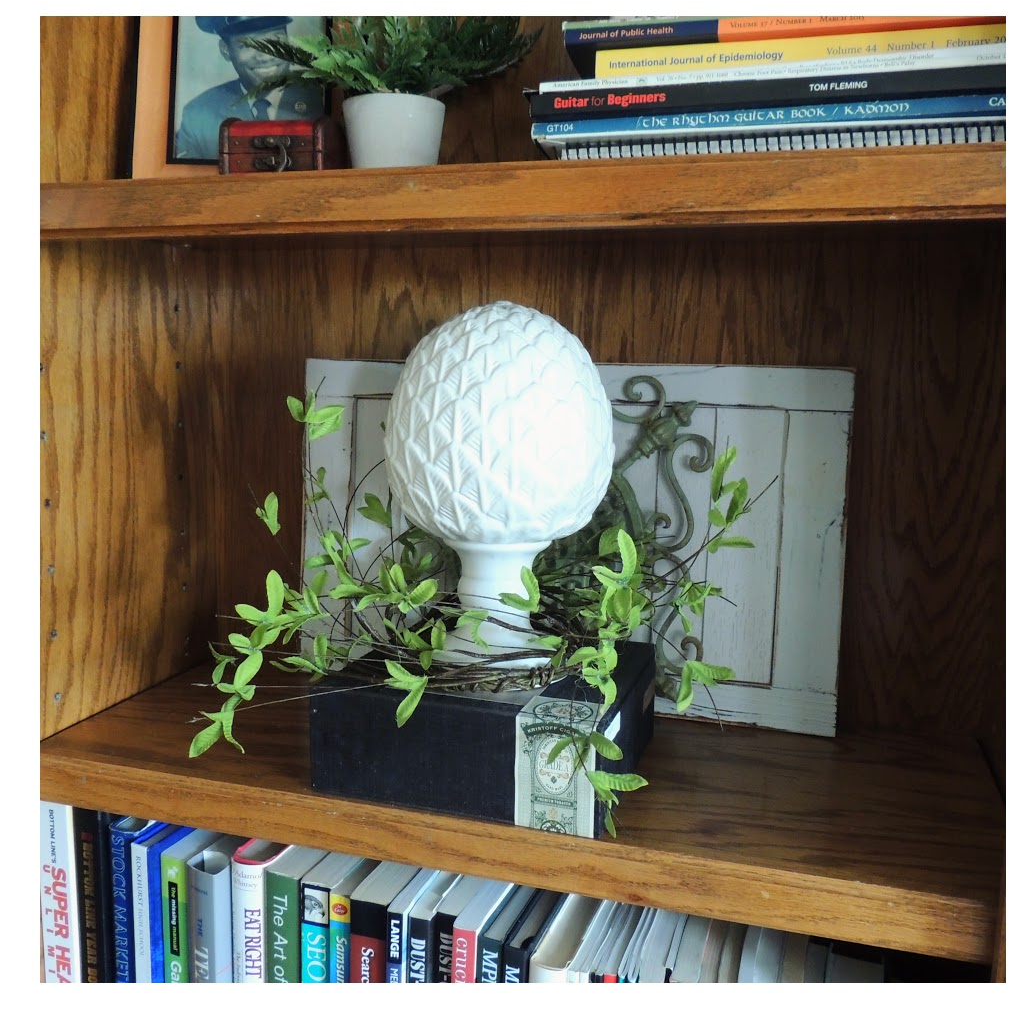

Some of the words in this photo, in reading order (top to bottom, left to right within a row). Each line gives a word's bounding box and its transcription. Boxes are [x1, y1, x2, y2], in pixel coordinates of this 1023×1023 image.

[579, 27, 608, 41] Journal
[610, 27, 619, 37] of
[620, 27, 645, 37] Public
[647, 25, 674, 35] Health
[608, 55, 667, 69] International
[669, 53, 704, 66] Journal
[706, 51, 718, 63] of
[719, 49, 784, 65] Epidemiology
[826, 46, 862, 56] Volume
[865, 44, 877, 53] 44
[888, 40, 926, 52] Number
[946, 38, 991, 47] February
[994, 35, 1006, 43] 20
[552, 80, 580, 89] American
[581, 80, 600, 89] Family
[601, 78, 628, 86] Physician
[788, 66, 818, 75] Respiratory
[554, 96, 590, 109] Guitar
[591, 95, 606, 107] for
[607, 93, 666, 107] Beginners
[808, 83, 828, 92] TOM
[829, 80, 868, 91] FLEMING
[546, 123, 574, 133] GT104
[790, 107, 826, 119] BOOK
[988, 97, 1006, 107] CA
[527, 725, 558, 734] KRISTOFF
[82, 841, 96, 895] BOTTOM
[111, 834, 126, 901] STOCK
[136, 855, 144, 907] ROCKHURST
[52, 867, 69, 939] SUPER
[84, 899, 96, 929] LINE
[273, 895, 288, 927] The
[244, 908, 261, 933] EAT
[86, 931, 98, 965] YEAR
[114, 905, 130, 982] MARKET
[274, 931, 289, 961] Art
[390, 919, 400, 960] LANGE
[245, 936, 262, 980] RIGHT
[274, 965, 289, 983] of
[306, 932, 326, 982] SEO
[361, 947, 375, 983] Searc
[482, 948, 499, 983] MP
[87, 967, 98, 983] BO
